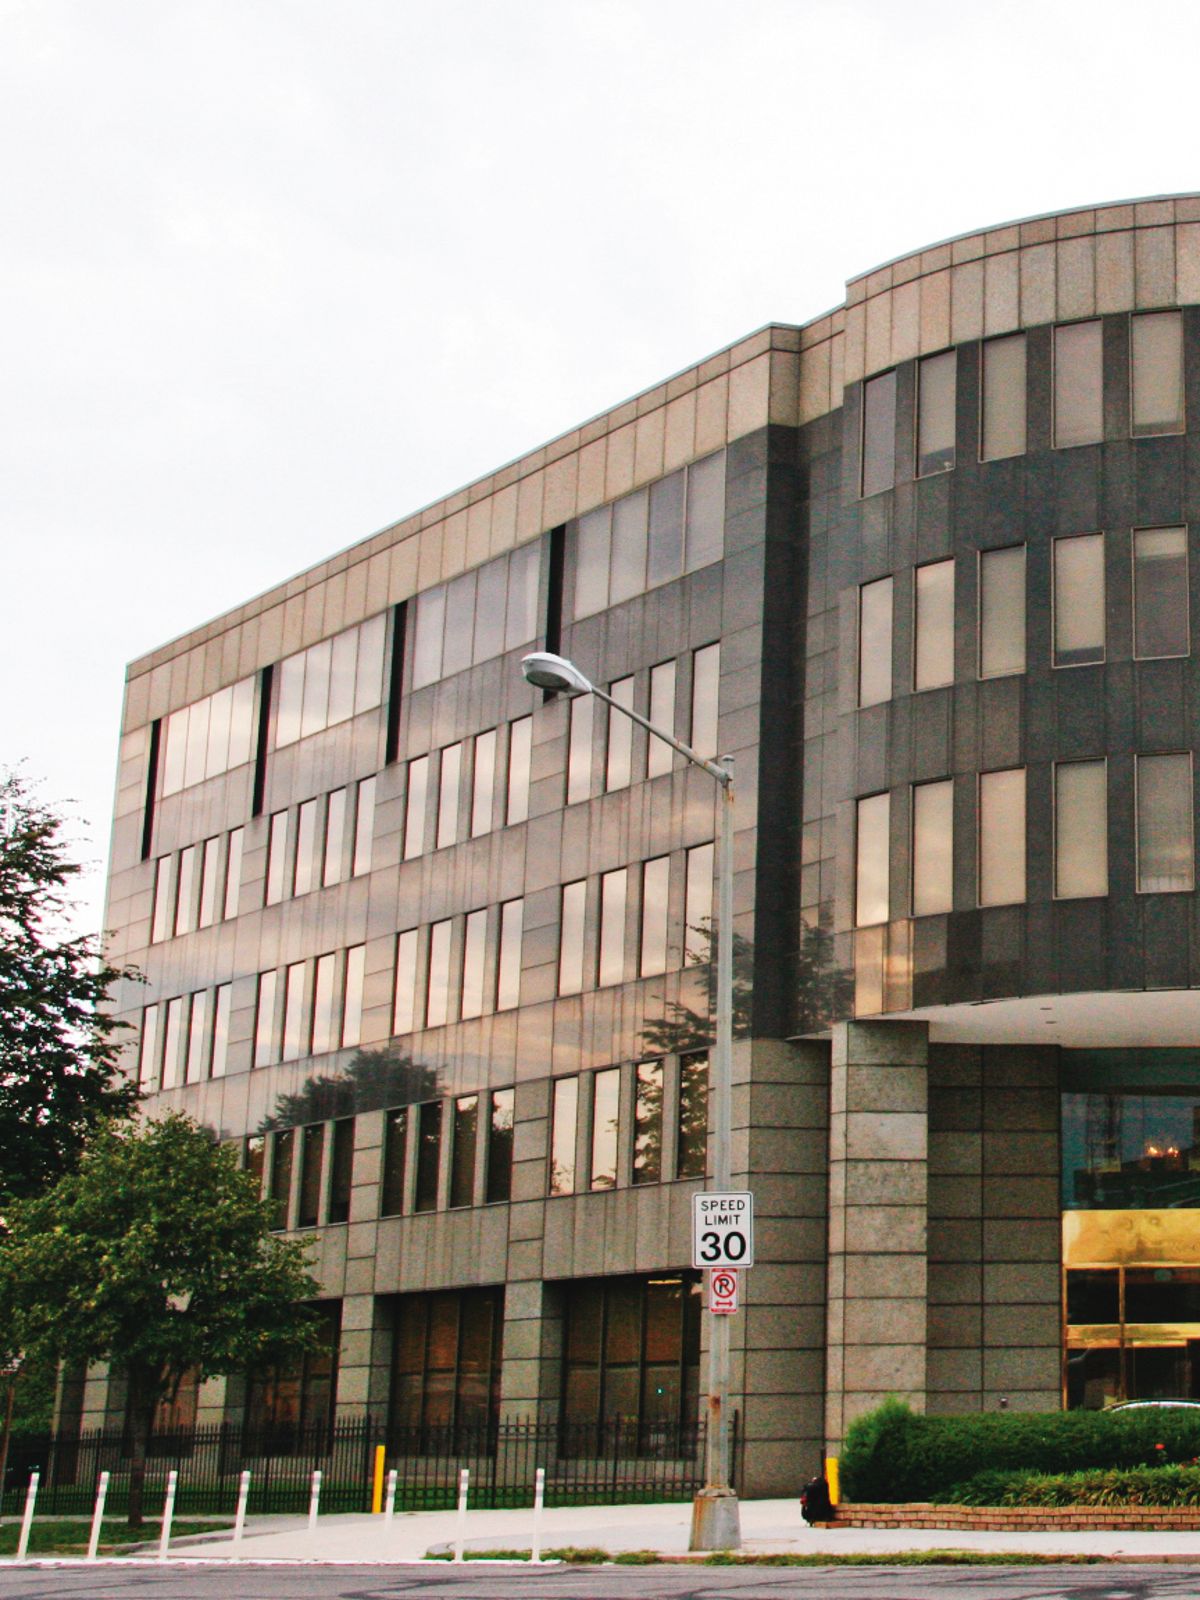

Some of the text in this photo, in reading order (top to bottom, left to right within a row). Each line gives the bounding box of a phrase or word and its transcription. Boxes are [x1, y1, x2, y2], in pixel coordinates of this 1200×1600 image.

[701, 1200, 745, 1211] SPEED
[705, 1215, 740, 1225] LIMIT
[701, 1232, 746, 1261] 30
